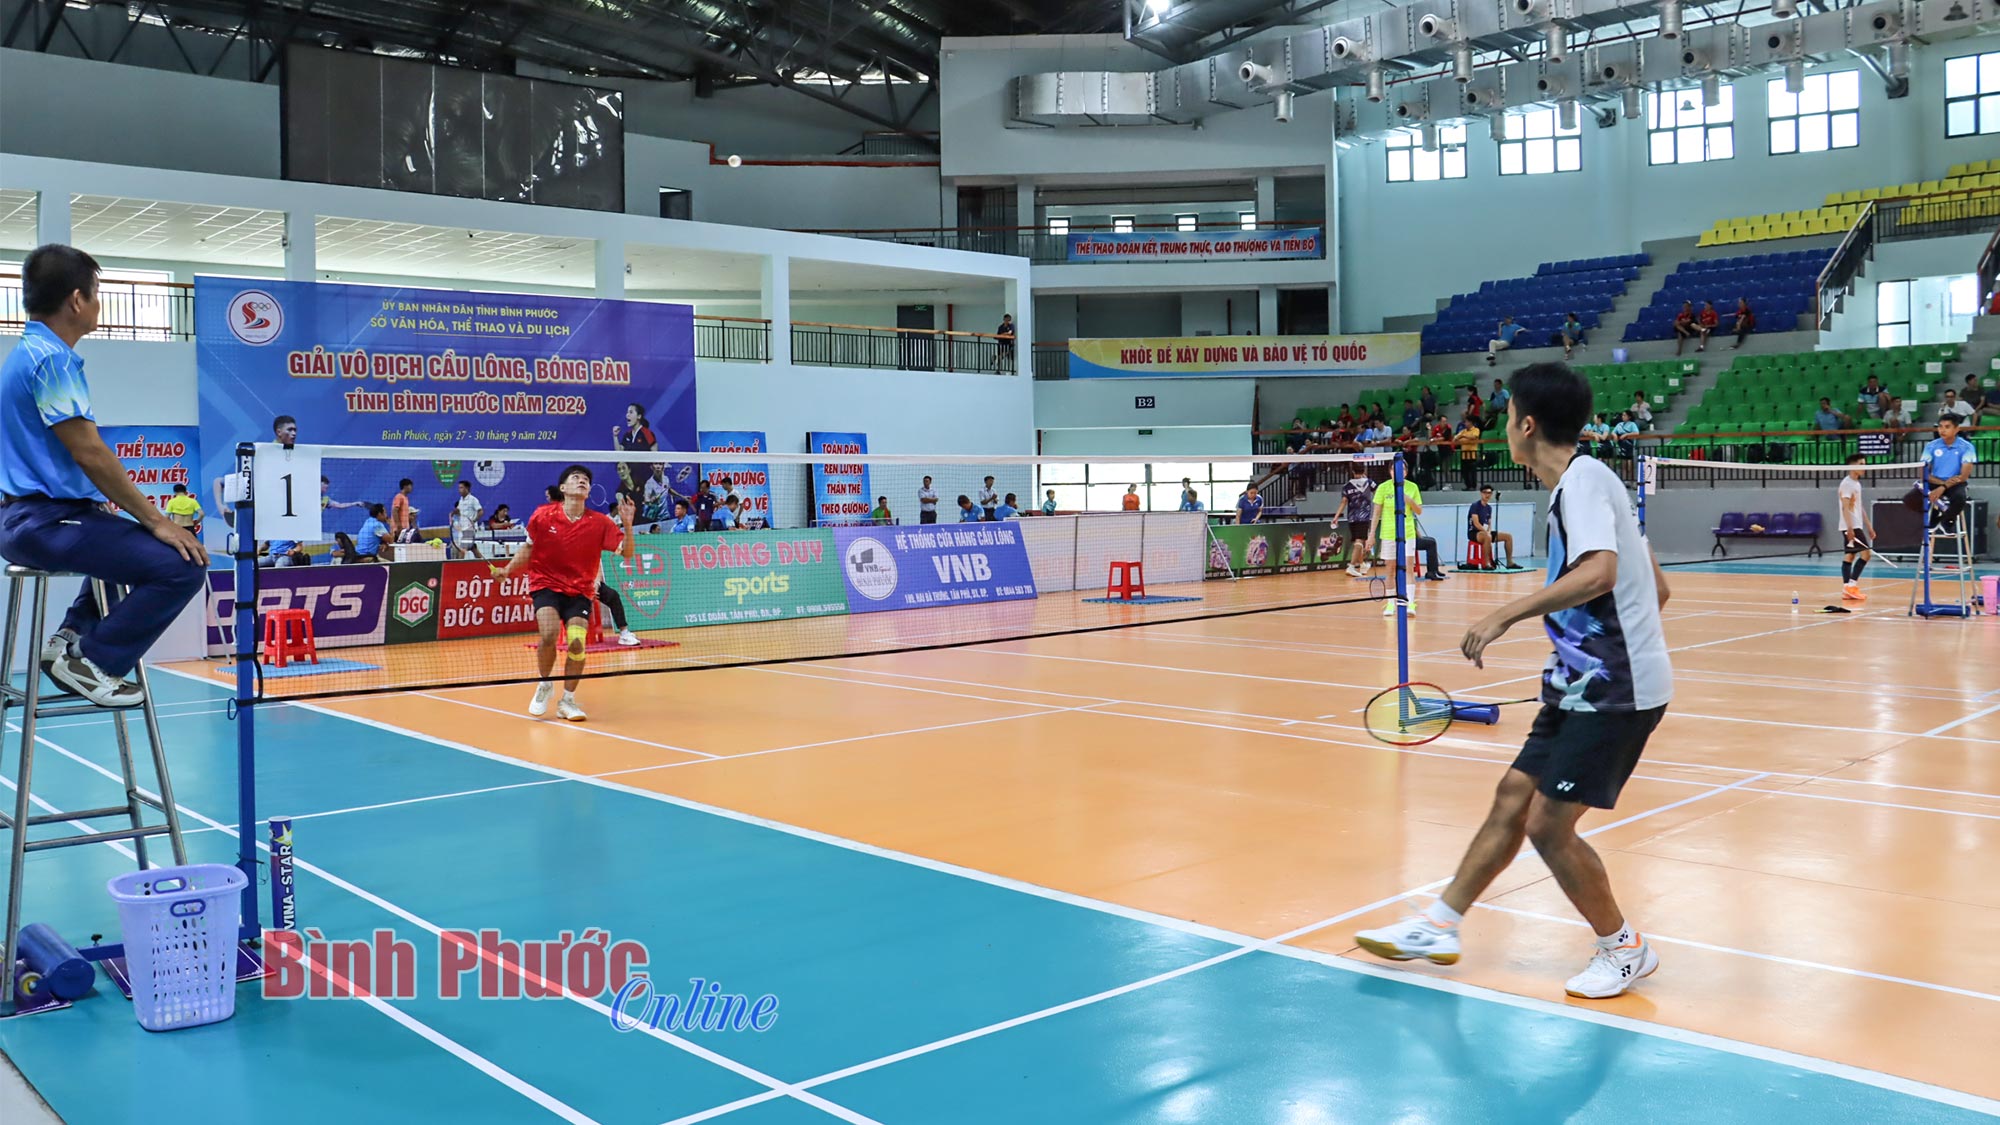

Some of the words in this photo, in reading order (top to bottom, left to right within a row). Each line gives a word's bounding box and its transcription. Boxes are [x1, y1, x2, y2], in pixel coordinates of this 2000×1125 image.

[1075, 236, 1091, 255] THỂ
[1092, 242, 1114, 255] THAO
[1116, 240, 1140, 254] ĐOÀN
[1160, 242, 1188, 255] TRUNG
[1214, 241, 1231, 254] CAO
[398, 302, 419, 312] BAN
[422, 302, 450, 313] NHÂN
[453, 303, 474, 315] DÂN
[476, 304, 498, 316] TỈNH
[500, 305, 523, 317] BÌNH
[525, 306, 559, 319] PHƯỚC
[370, 314, 387, 328] SỞ
[390, 317, 416, 329] VĂN
[419, 317, 449, 332] HÓA,
[452, 316, 472, 332] THỂ
[474, 322, 505, 333] THAO
[508, 321, 524, 333] VÀ
[527, 324, 542, 334] DU
[545, 324, 570, 338] LỊCH
[1120, 345, 1153, 365] KHỎE
[1157, 343, 1172, 364] ĐỂ
[1176, 345, 1199, 363] XÂY
[1203, 345, 1238, 365] DỰNG
[1242, 344, 1259, 362] VÀ
[1263, 343, 1288, 362] BẢO
[1292, 343, 1308, 364] VỆ
[1312, 341, 1327, 361] TỔ
[1332, 341, 1367, 362] QUỐC
[288, 346, 335, 378] GIẢI
[338, 349, 369, 379] VÔ
[373, 354, 424, 383] ĐỊCH
[428, 349, 469, 381] CẦU
[473, 353, 532, 385] LÔNG,
[535, 354, 588, 383] BÓNG
[591, 356, 630, 384] BÀN
[345, 387, 389, 413] TỈNH
[393, 389, 437, 413] BÌNH
[441, 390, 498, 414] PHƯỚC
[503, 391, 543, 414] NĂM
[546, 395, 587, 415] 2024
[1137, 397, 1153, 408] B2
[116, 435, 144, 458] THỂ
[146, 442, 186, 458] THAO
[382, 430, 401, 440] Bình
[434, 430, 453, 442] ngày
[456, 430, 467, 440] 27
[474, 430, 485, 440] 30
[487, 430, 509, 443] tháng
[511, 431, 517, 440] 9
[518, 431, 535, 440] năm
[537, 430, 557, 440] 2024
[127, 465, 158, 485] OÀN
[161, 462, 190, 486] KẾT,
[733, 469, 767, 490] DỰNG
[280, 473, 298, 517] 1
[754, 493, 768, 514] VỆ
[821, 502, 841, 515] THEO
[895, 531, 908, 552] HỆ
[908, 528, 937, 549] THỐNG
[936, 528, 955, 548] CỬA
[954, 529, 977, 547] HÀNG
[977, 526, 994, 546] CẦU
[994, 528, 1016, 545] LÔNG
[680, 536, 772, 570] HOÀNG
[776, 539, 823, 565] DUY
[864, 564, 879, 573] VNB
[931, 553, 992, 584] VNB
[456, 575, 494, 602] BỘT
[500, 574, 530, 600] GIẶ
[724, 570, 790, 605] sports
[400, 595, 429, 614] DGC
[443, 603, 485, 628] ĐỨC
[491, 604, 535, 624] GIAN
[684, 614, 698, 623] 125
